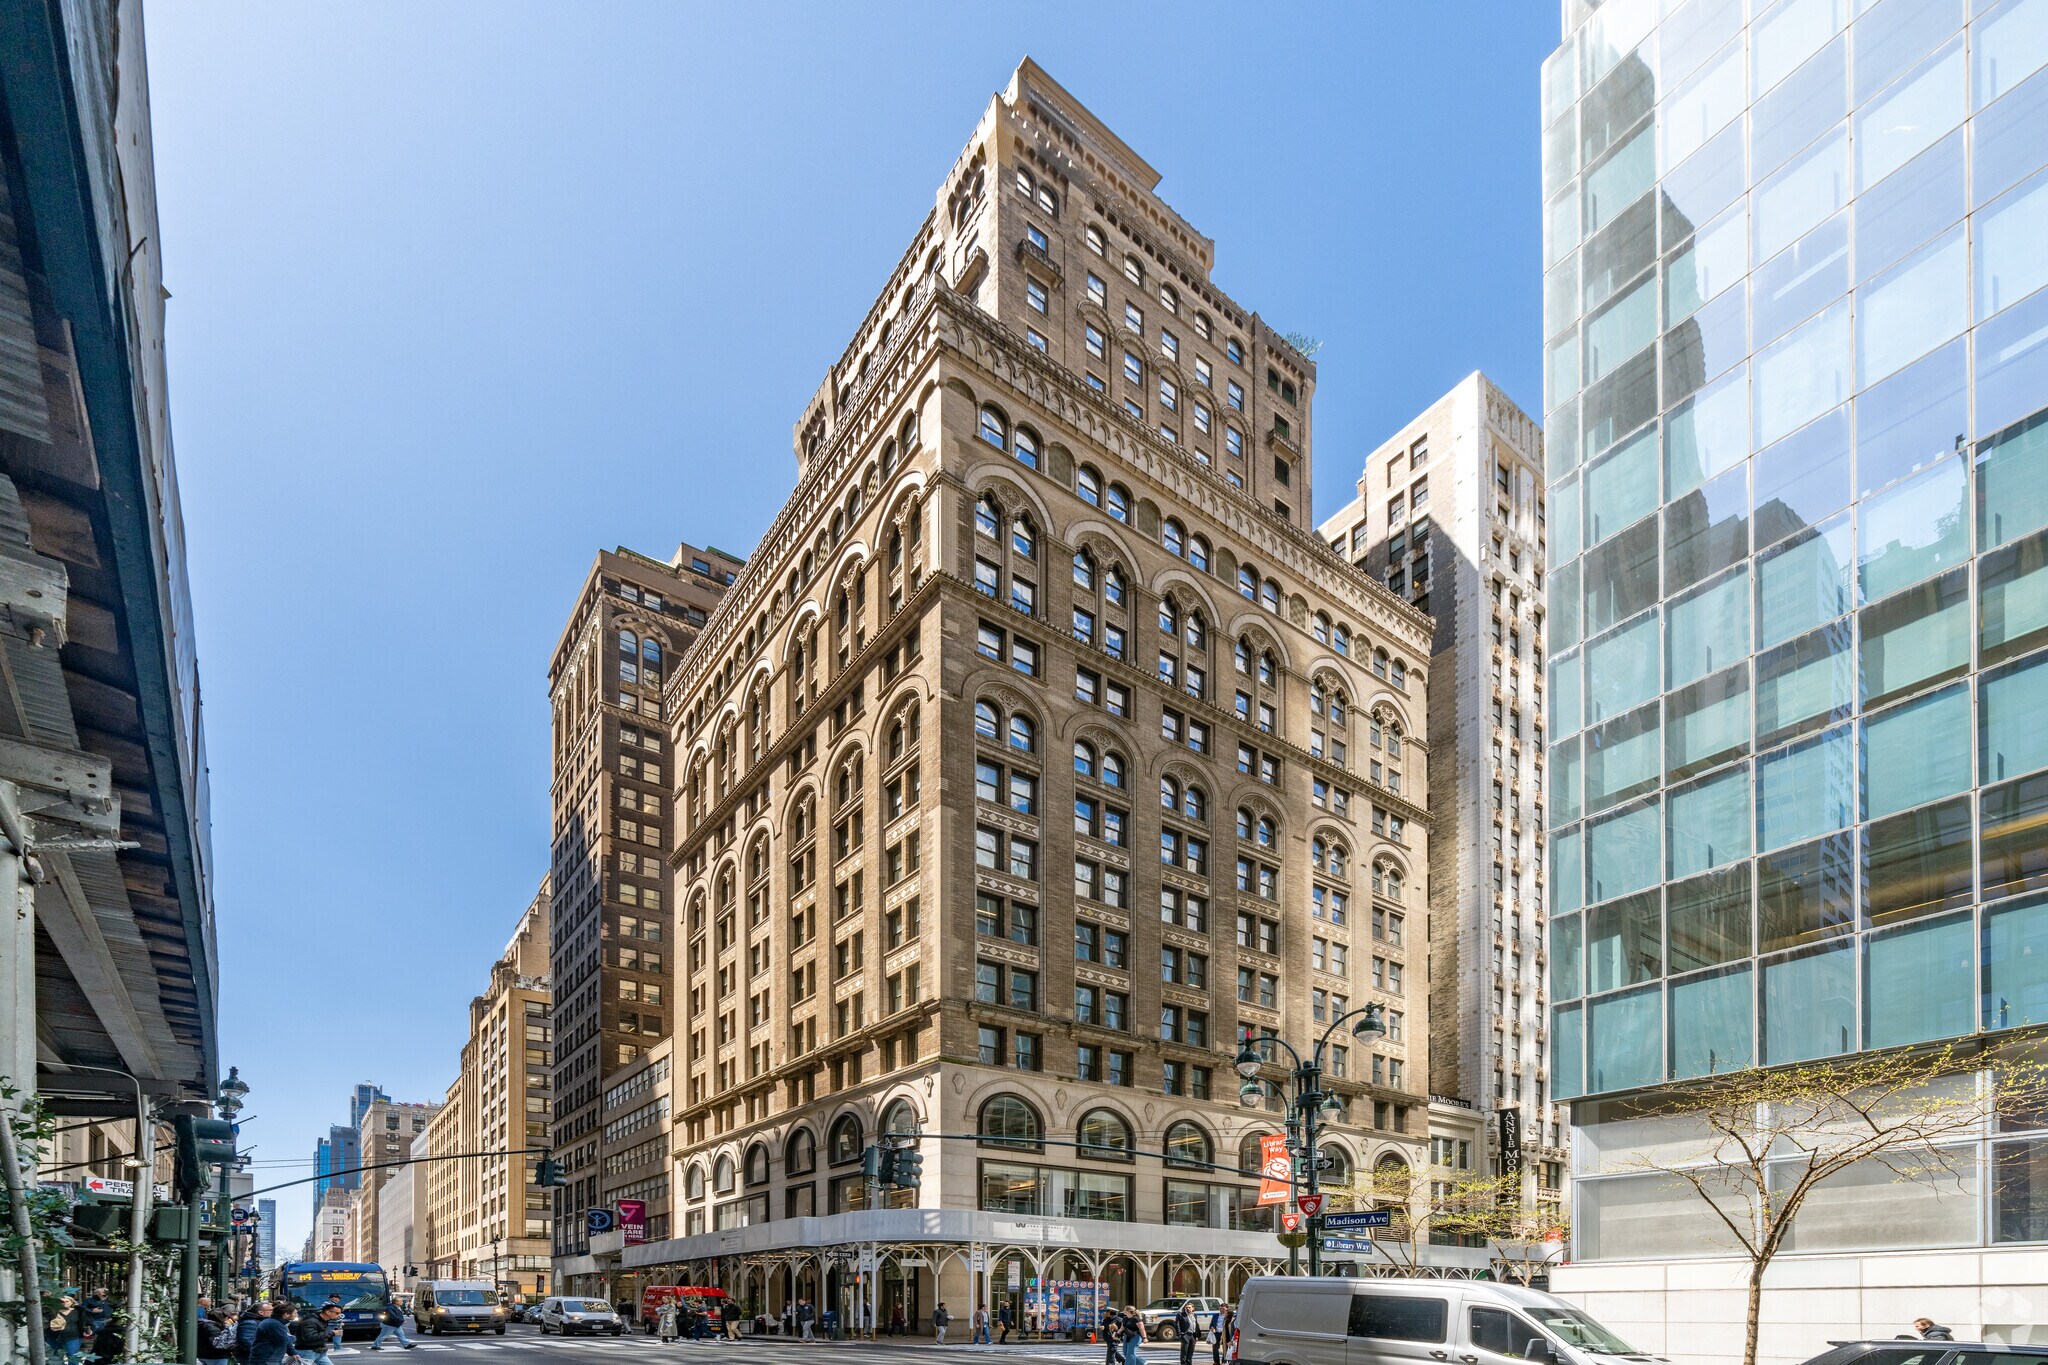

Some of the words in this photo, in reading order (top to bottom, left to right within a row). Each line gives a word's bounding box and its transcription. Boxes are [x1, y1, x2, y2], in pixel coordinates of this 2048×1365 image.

[1437, 1095, 1469, 1108] MOORE'S
[1504, 1111, 1516, 1148] ANNIE
[1263, 1140, 1286, 1148] Librar
[105, 1181, 166, 1193] PERSAL
[1327, 1217, 1366, 1226] Madison
[1368, 1215, 1387, 1223] Ave
[1331, 1240, 1355, 1250] Library
[1356, 1243, 1370, 1252] Way
